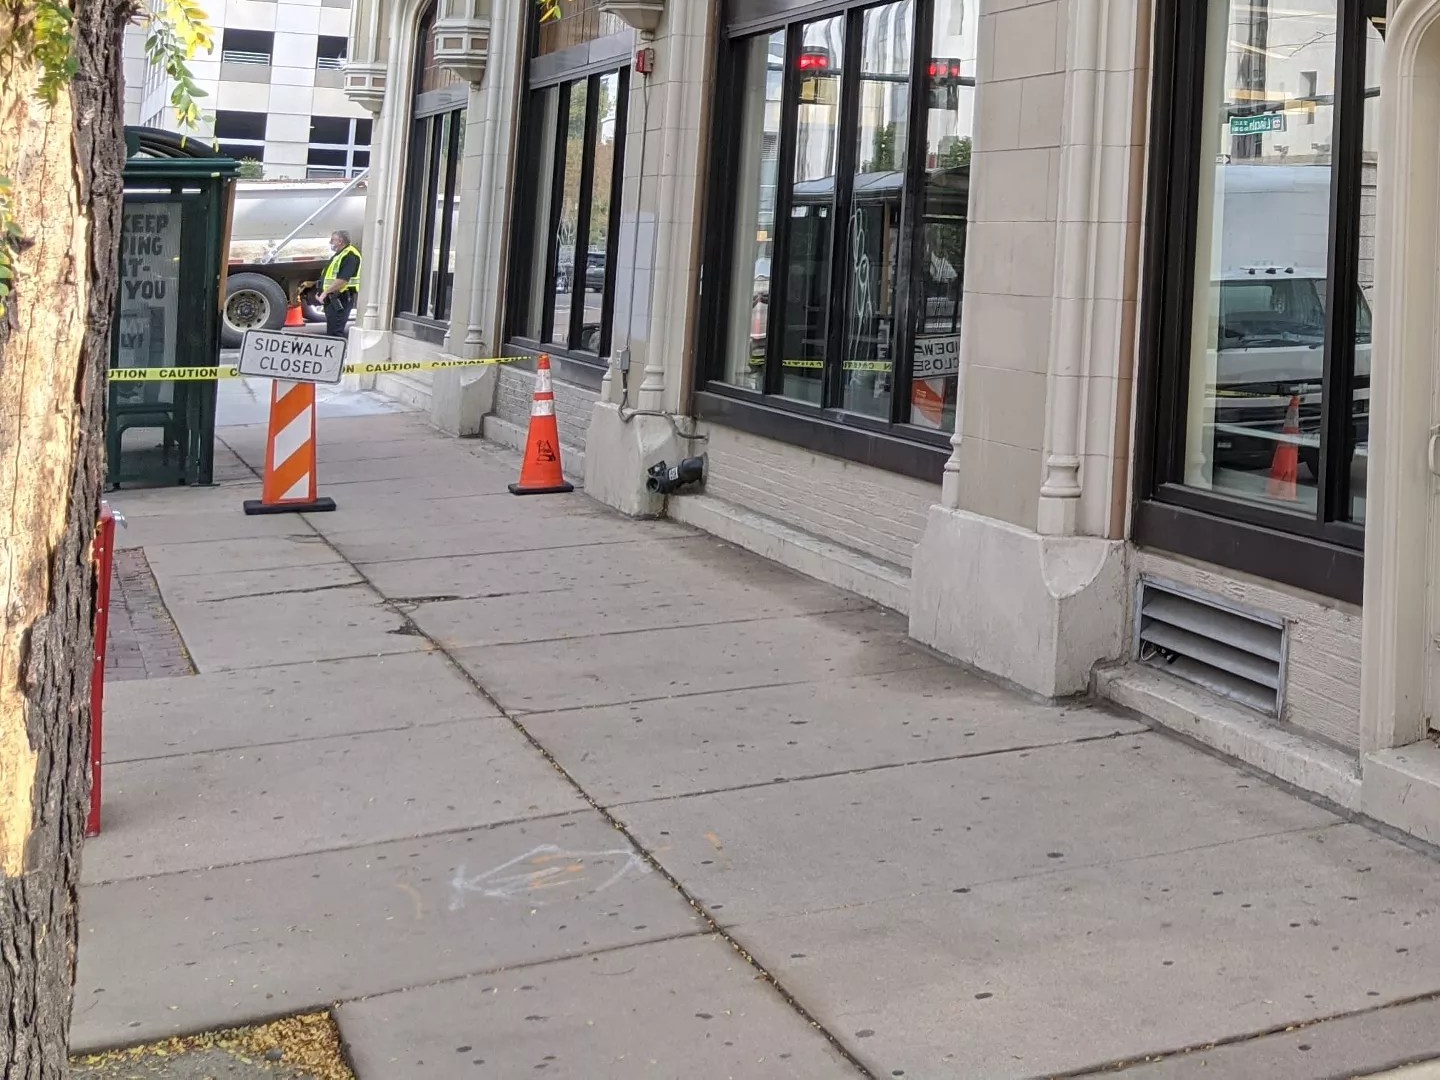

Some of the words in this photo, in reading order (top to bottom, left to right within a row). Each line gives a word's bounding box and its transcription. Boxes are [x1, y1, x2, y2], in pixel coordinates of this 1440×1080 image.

[125, 280, 166, 300] YOU
[254, 338, 335, 358] SIDEWALK
[108, 369, 147, 379] UTION
[159, 368, 218, 378] CAUTION
[260, 357, 322, 375] CLOSED
[365, 362, 421, 373] CAUTION
